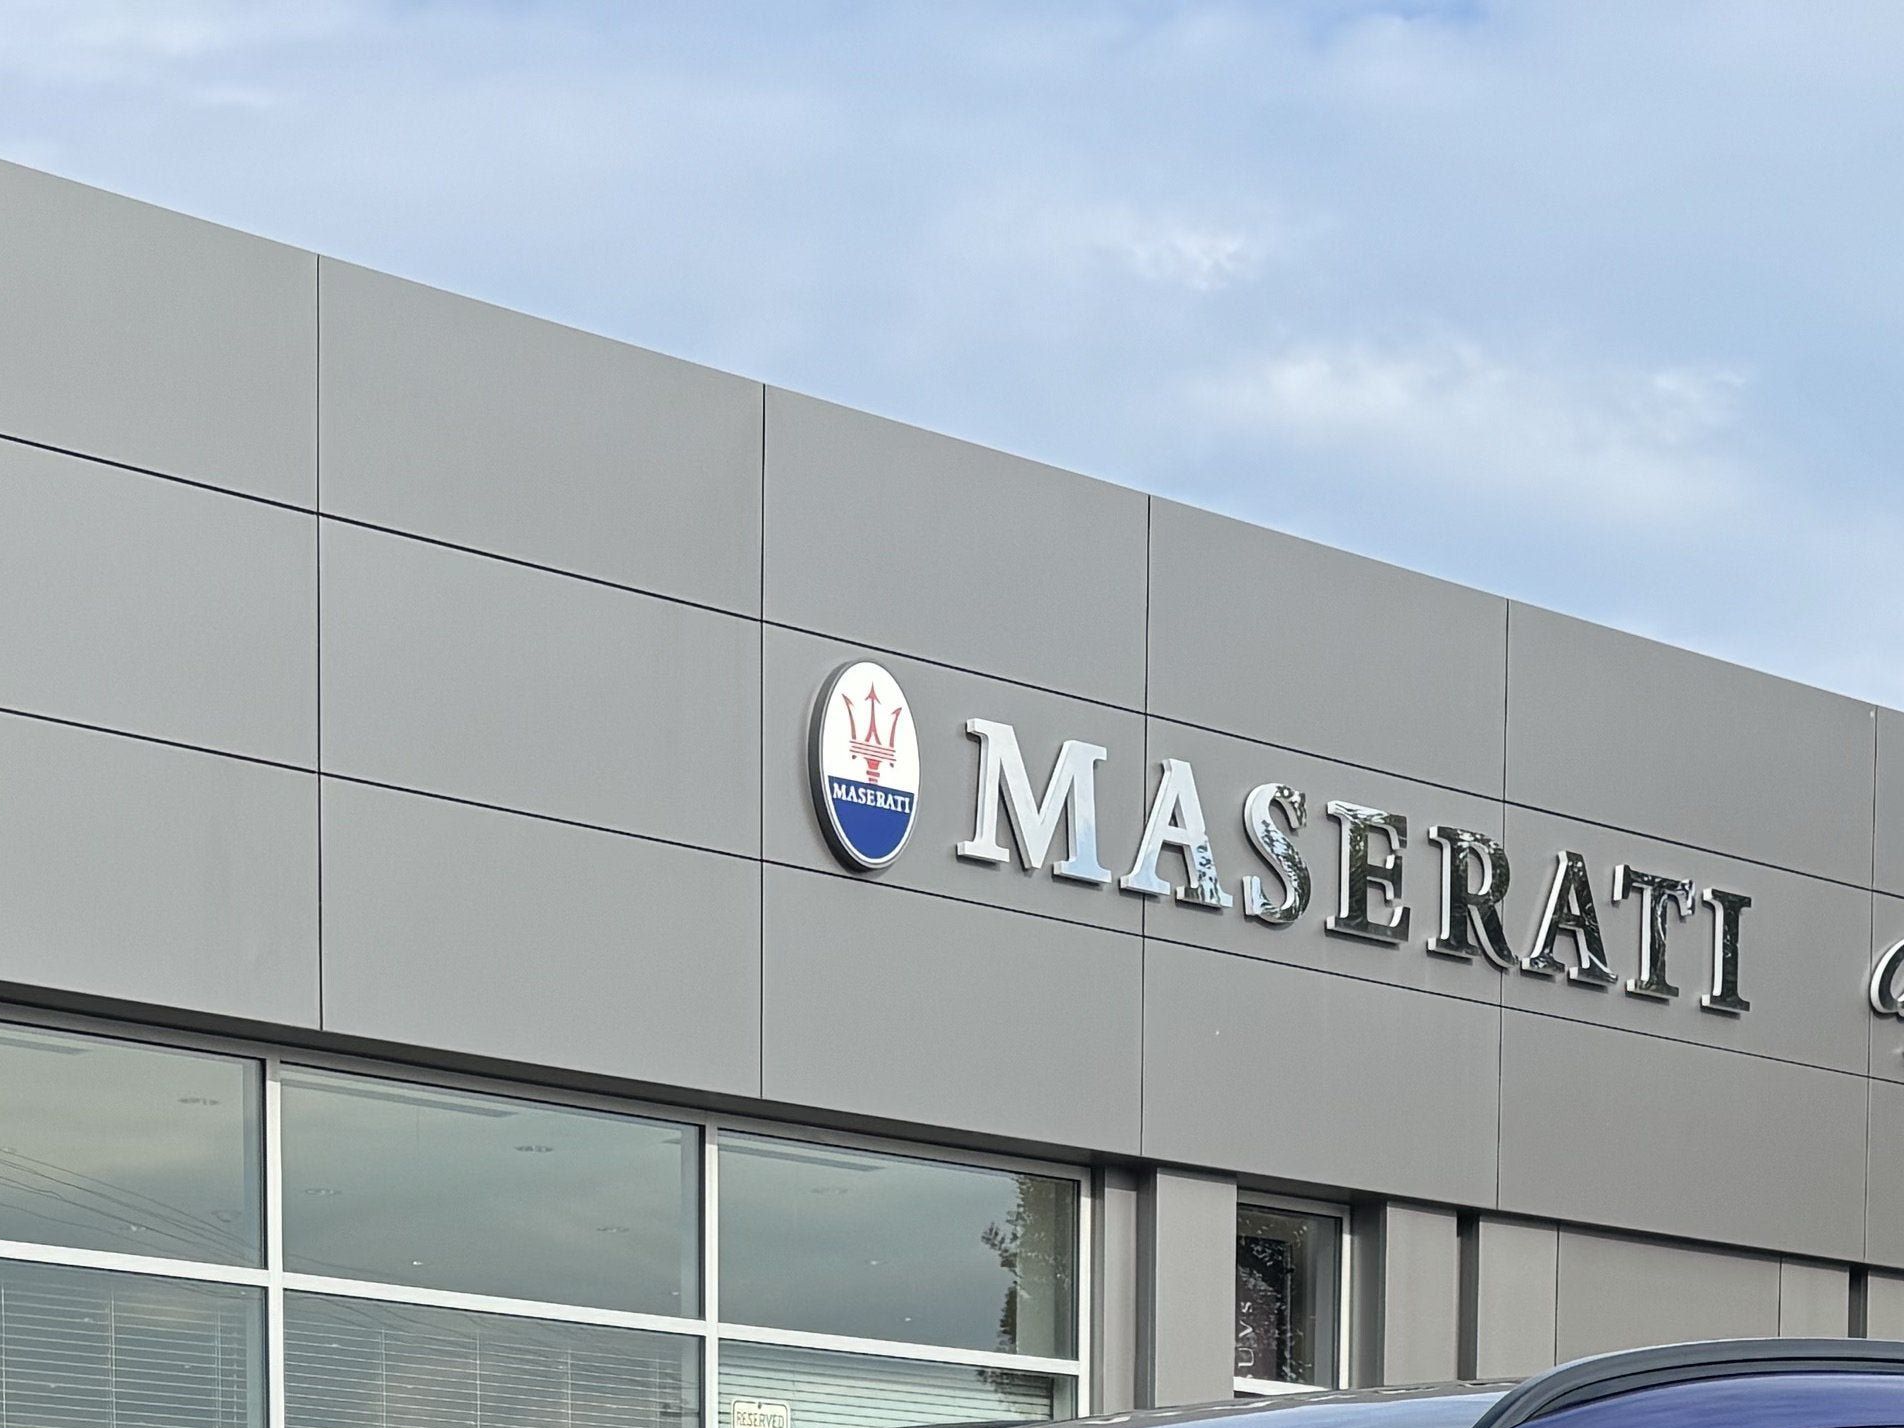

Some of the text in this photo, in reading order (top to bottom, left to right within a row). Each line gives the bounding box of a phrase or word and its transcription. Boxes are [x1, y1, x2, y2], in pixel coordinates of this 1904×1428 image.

[832, 782, 911, 814] MASERATI
[956, 717, 1752, 1014] MASERATI
[1237, 1301, 1255, 1379] UVs
[736, 1411, 785, 1428] RESERVED
